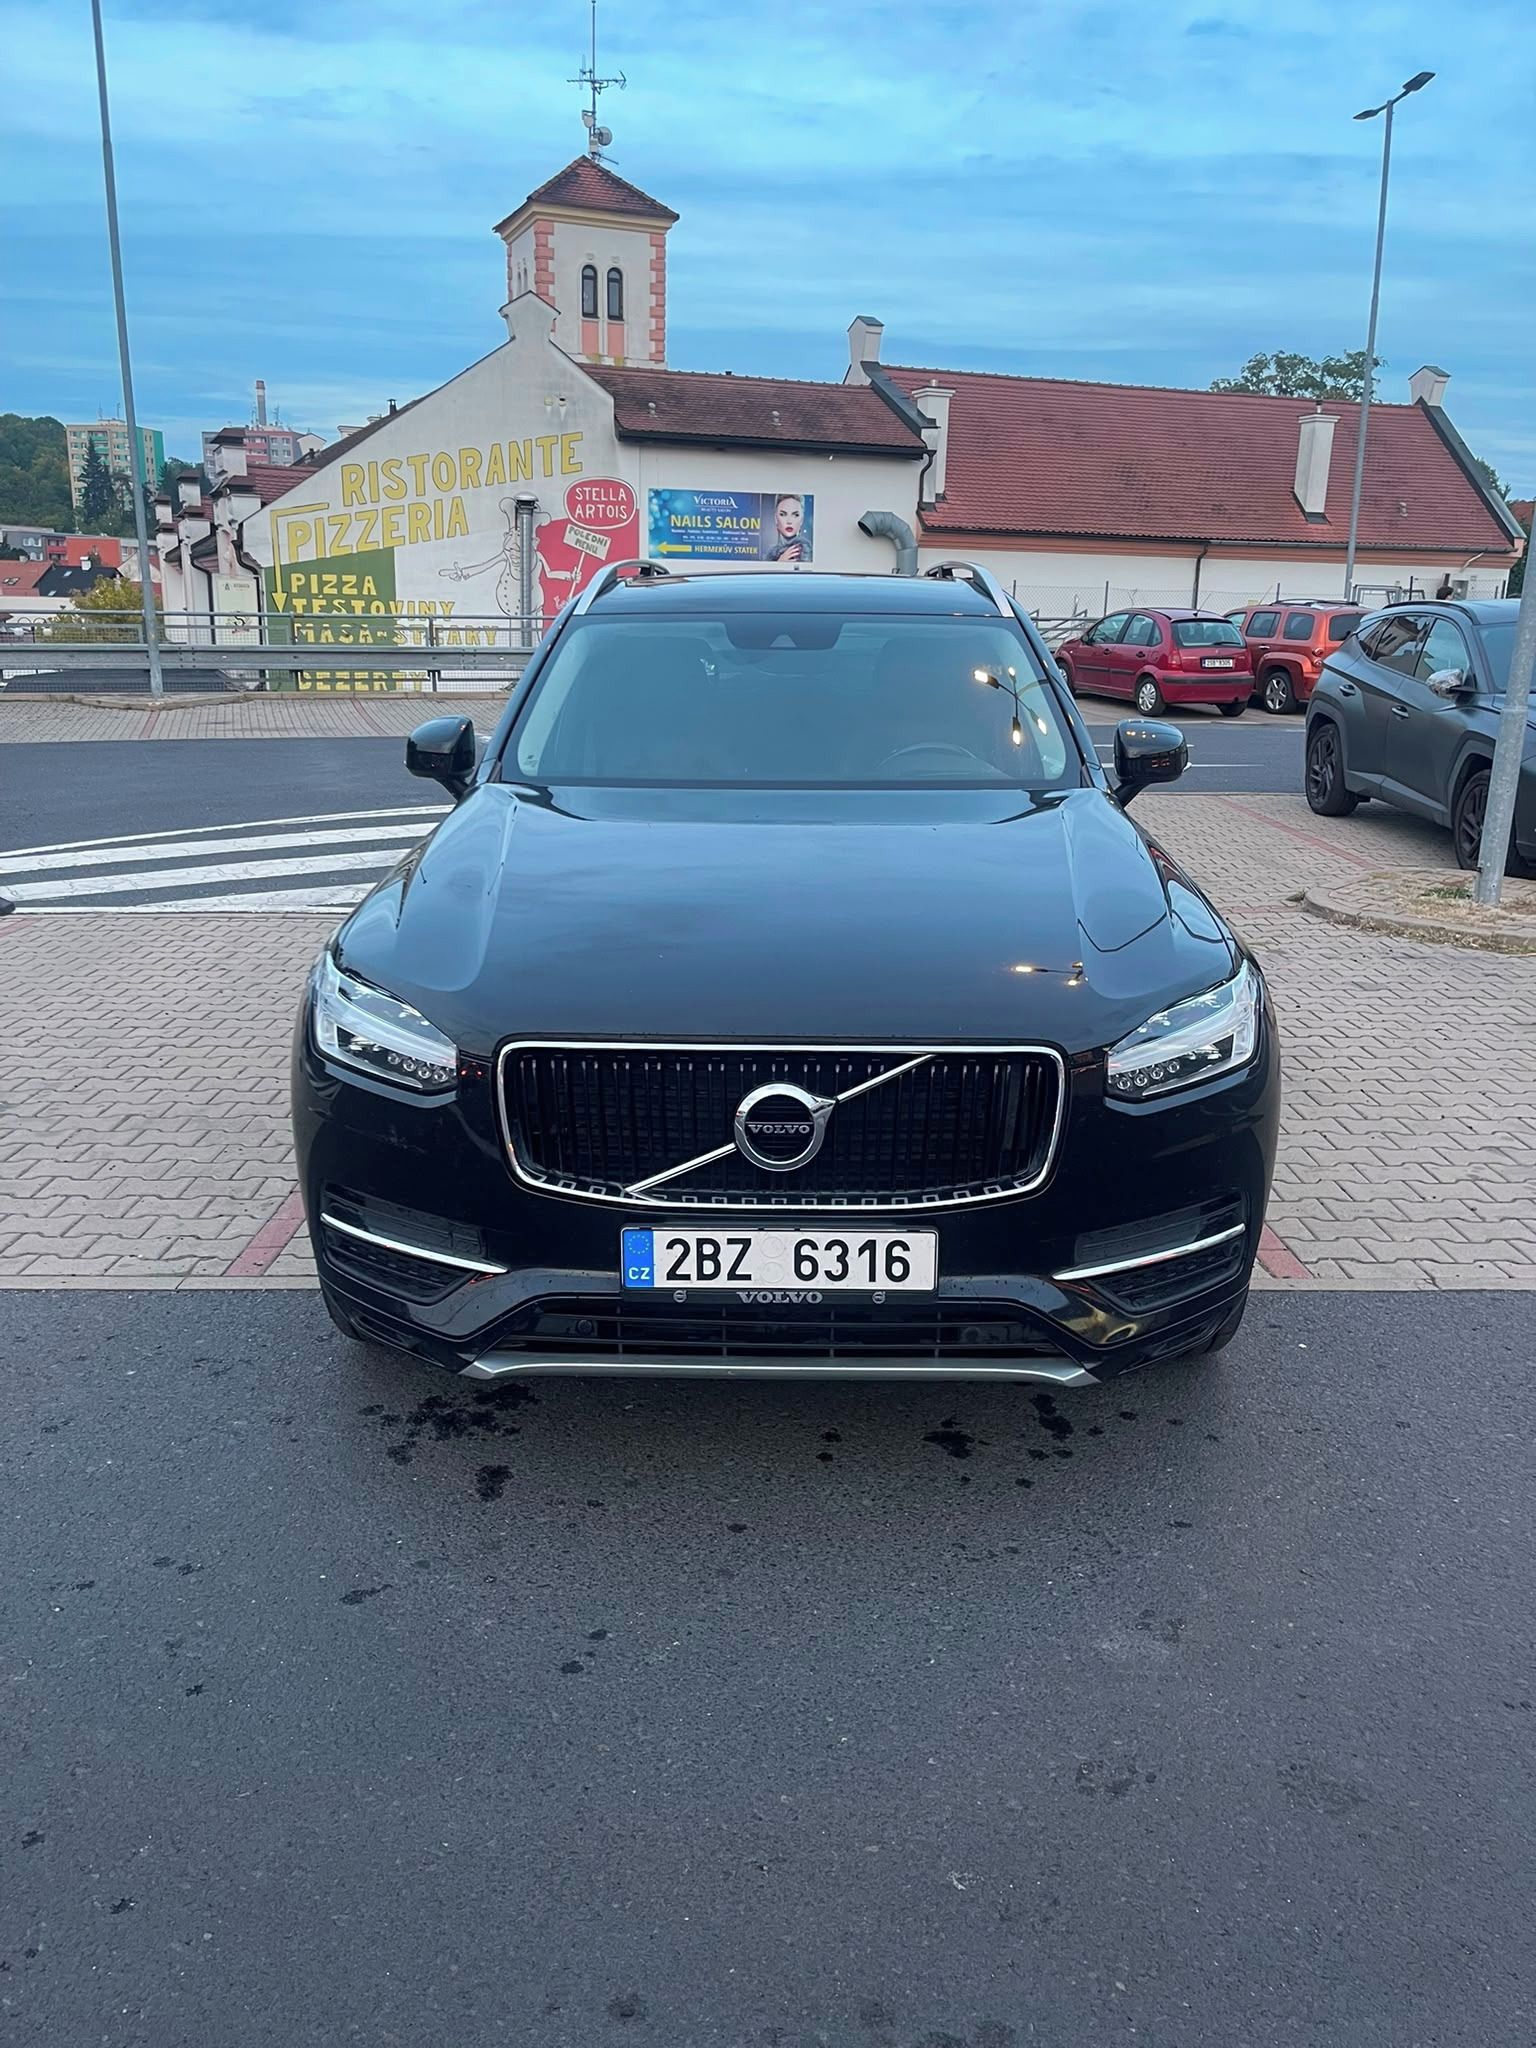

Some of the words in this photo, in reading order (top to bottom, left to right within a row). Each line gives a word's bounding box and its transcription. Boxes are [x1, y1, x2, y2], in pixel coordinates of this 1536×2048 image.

[340, 431, 584, 507] RISTORANTE
[575, 487, 627, 501] STELLA
[575, 504, 628, 519] ARTOIS
[286, 495, 470, 562] PIZZERIA
[670, 515, 712, 528] NAILS
[715, 518, 761, 530] SALON
[574, 538, 598, 554] MENU
[290, 573, 377, 596] PIZZA
[748, 1124, 810, 1134] VOLVO
[665, 1237, 752, 1281] 2BZ
[793, 1238, 911, 1283] 6316
[628, 1267, 650, 1280] CZ
[736, 1291, 824, 1304] VOLVO
